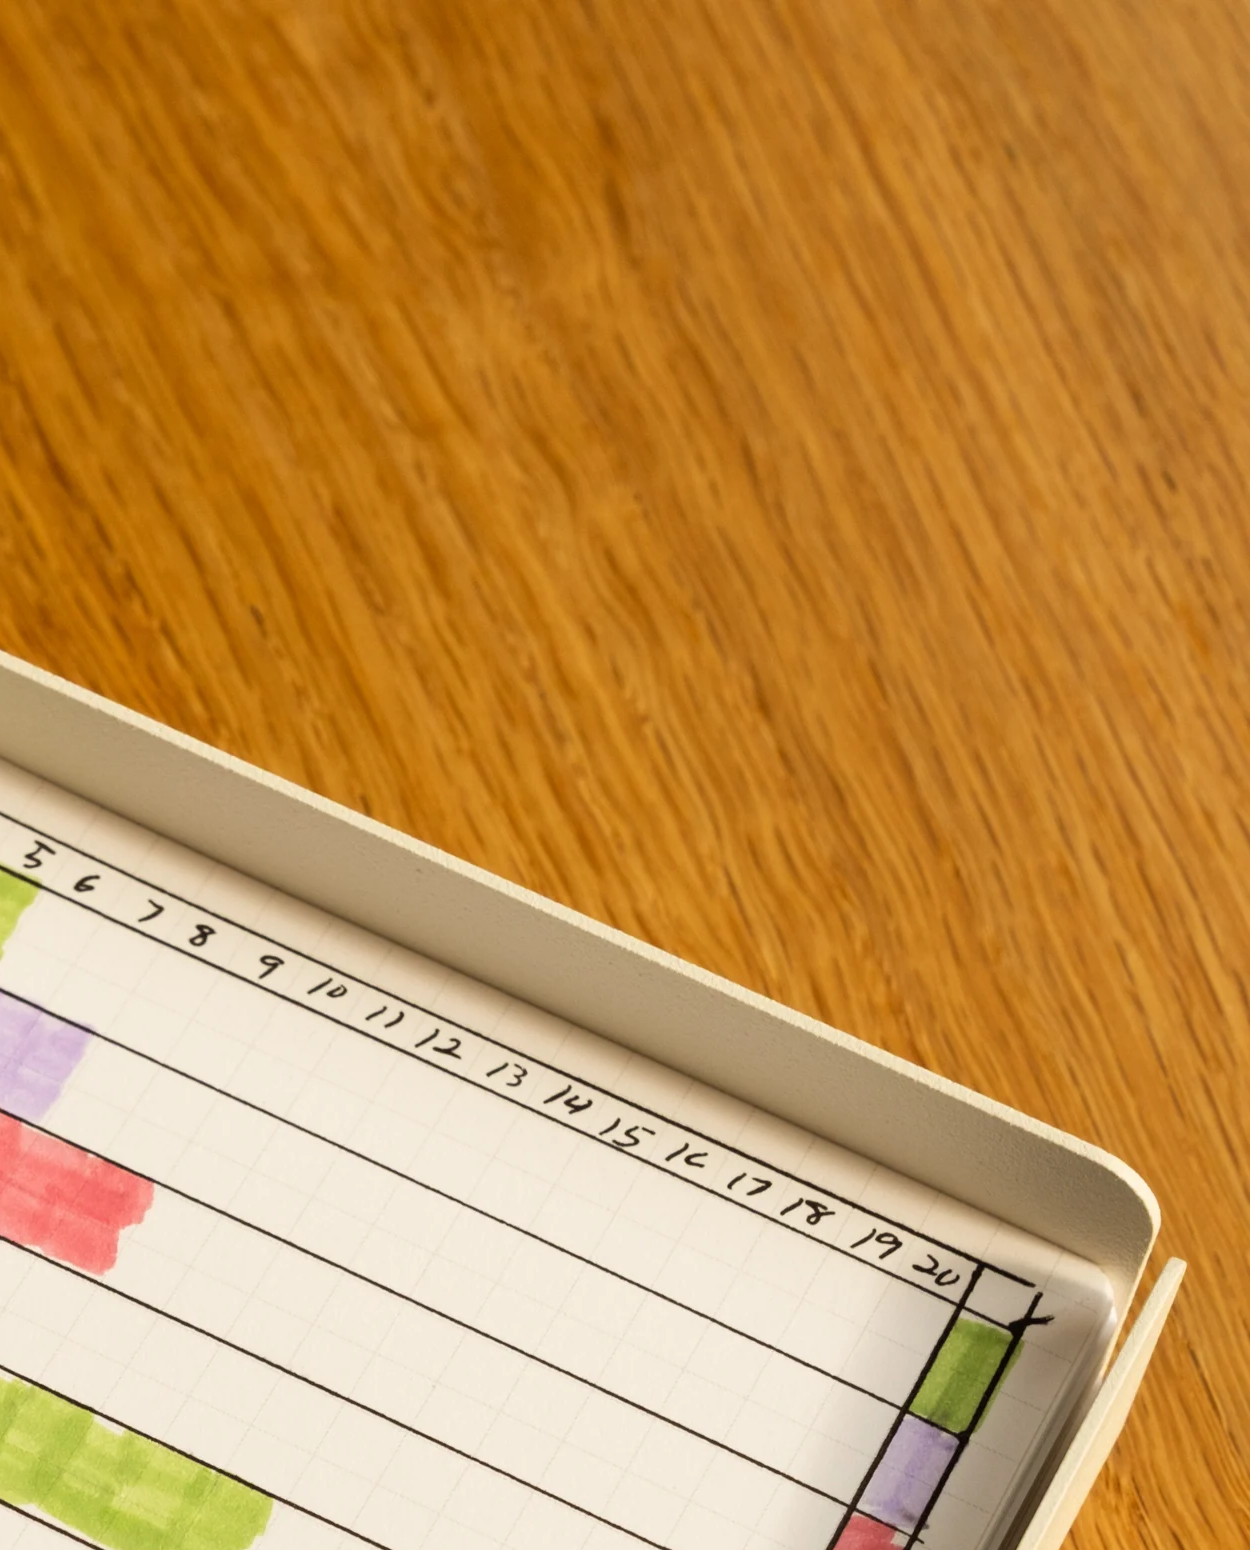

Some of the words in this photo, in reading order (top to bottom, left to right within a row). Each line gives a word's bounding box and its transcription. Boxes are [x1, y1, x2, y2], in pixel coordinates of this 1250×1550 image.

[22, 840, 56, 870] 5
[73, 874, 101, 893] 6
[137, 899, 165, 923] 7
[188, 924, 217, 947] 8
[258, 954, 285, 979] 9
[307, 978, 348, 999] 10
[365, 1006, 405, 1028] 11
[415, 1029, 463, 1060] 12
[486, 1062, 528, 1088] 13
[543, 1085, 593, 1115] 14
[599, 1118, 656, 1149] 15
[727, 1173, 772, 1196] 17
[779, 1198, 836, 1226] 18
[850, 1228, 903, 1261] 19
[911, 1255, 962, 1287] 20
